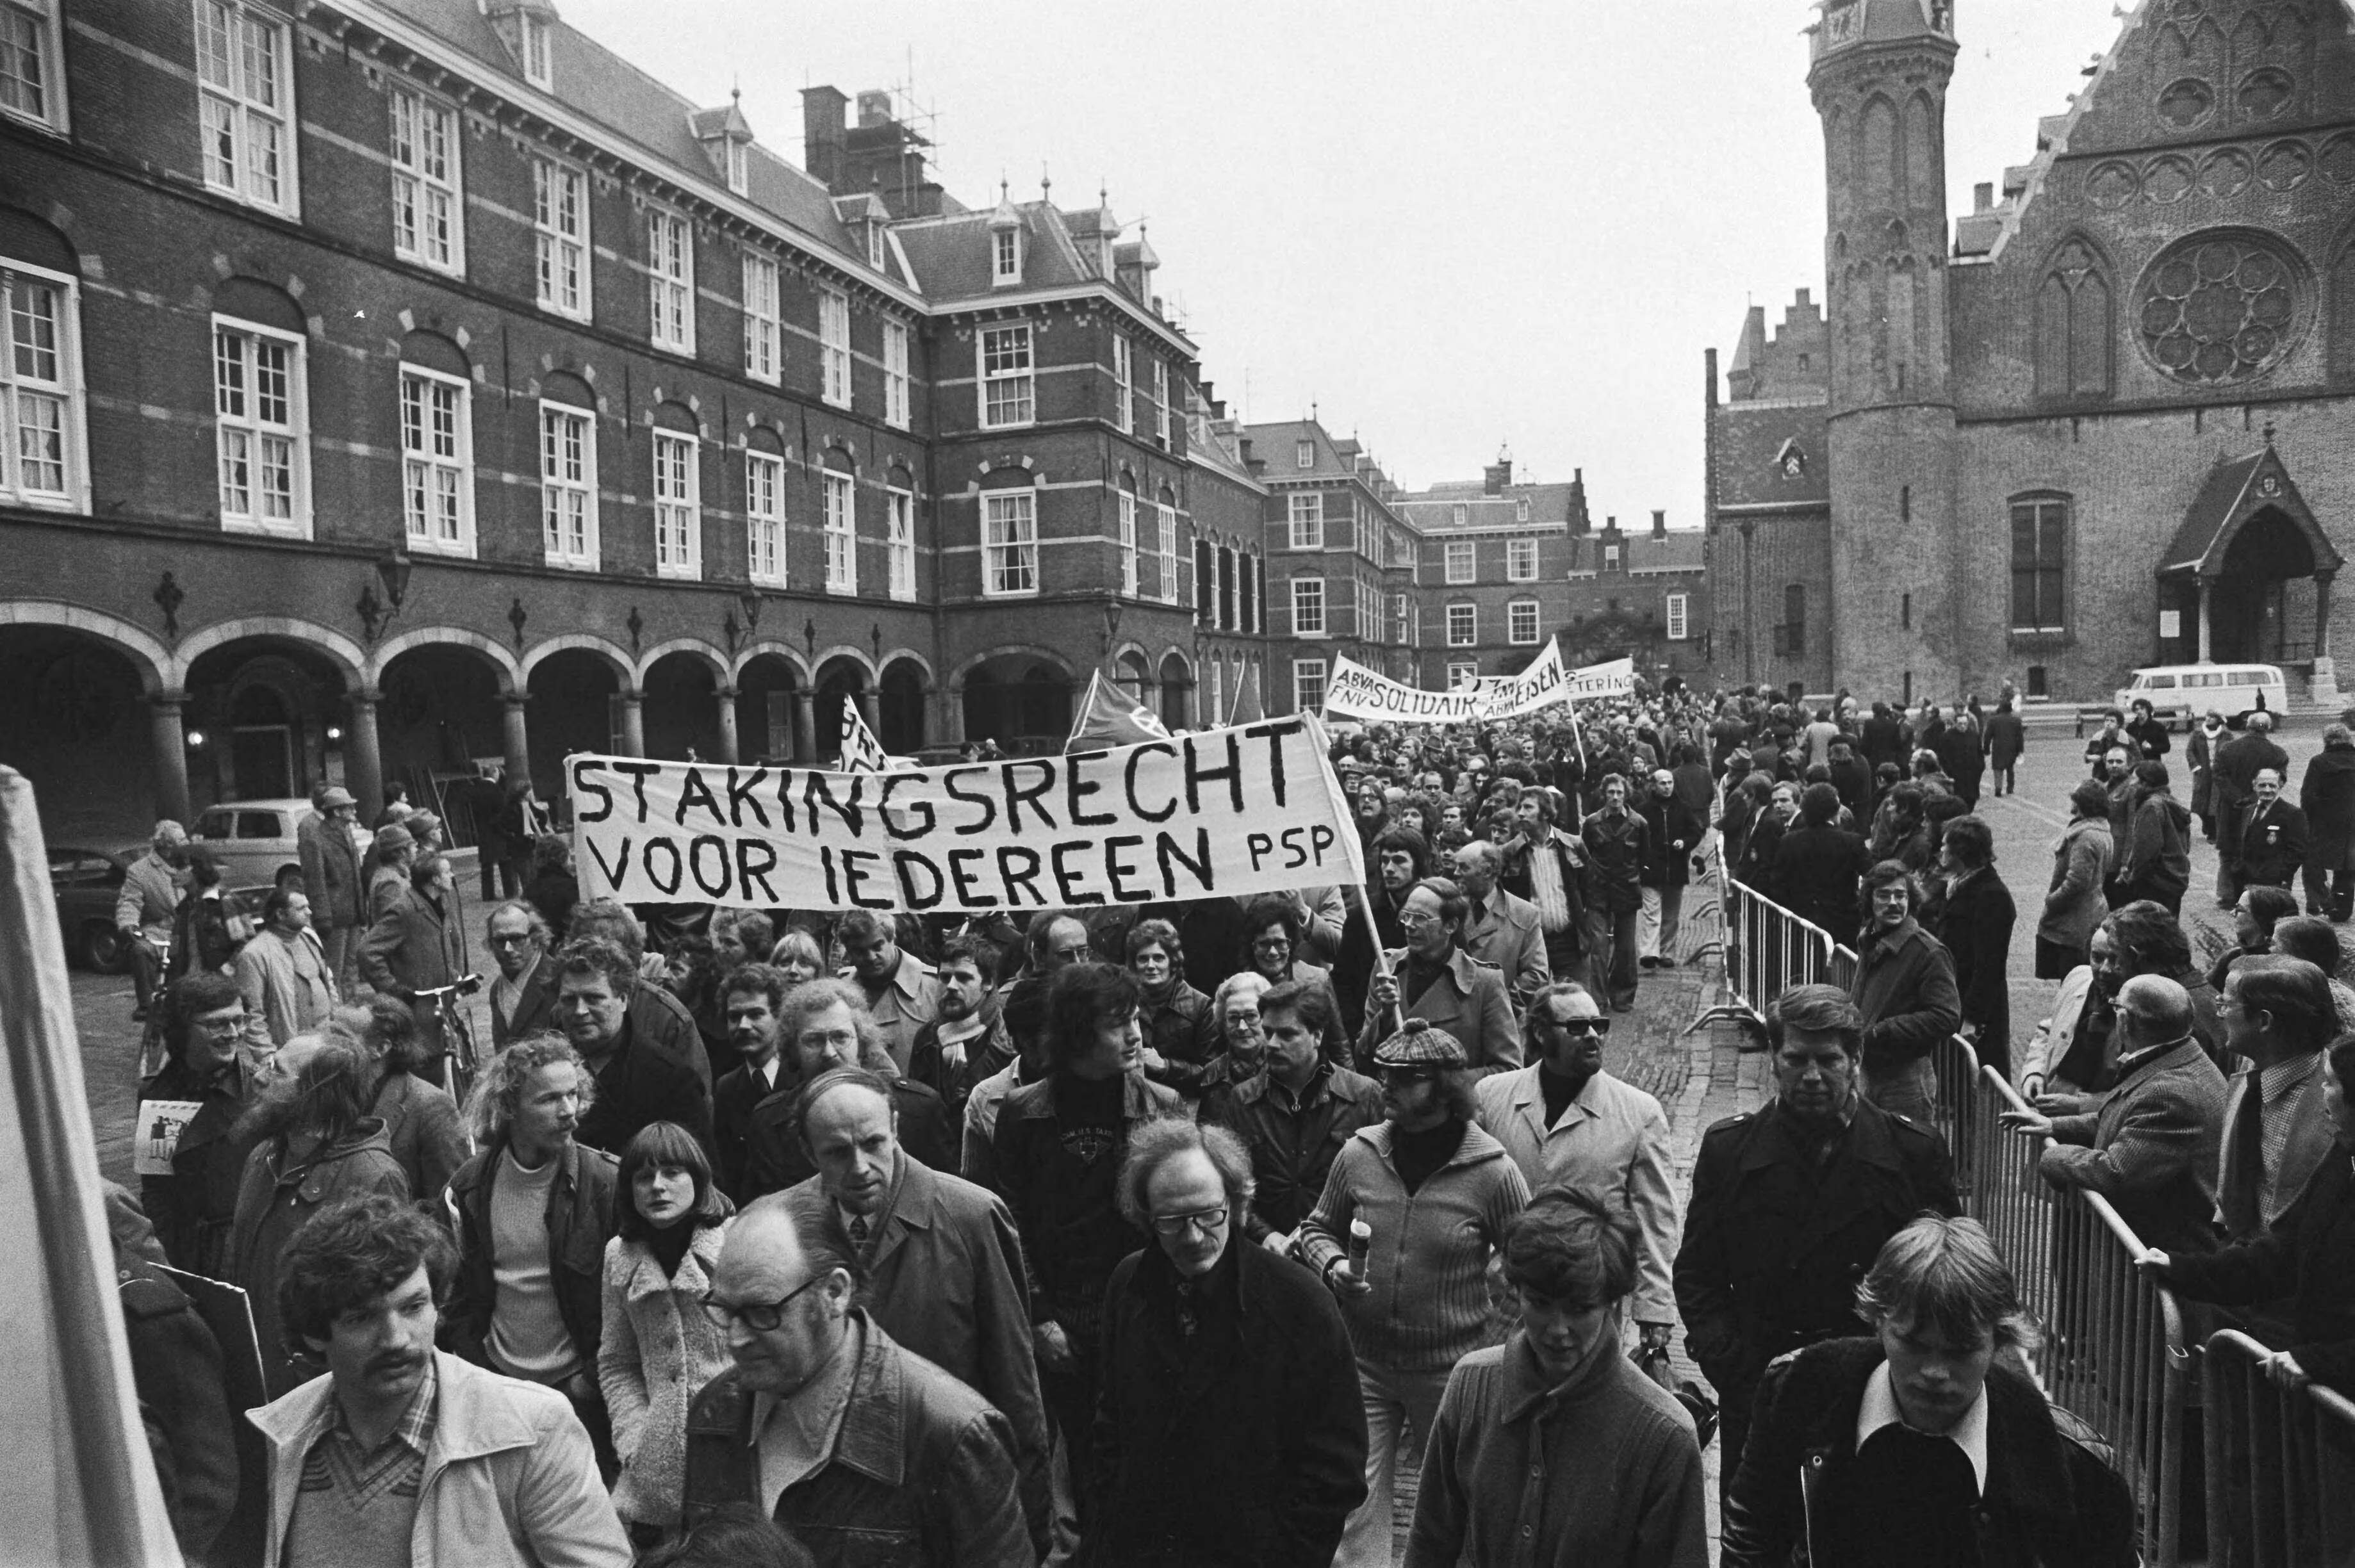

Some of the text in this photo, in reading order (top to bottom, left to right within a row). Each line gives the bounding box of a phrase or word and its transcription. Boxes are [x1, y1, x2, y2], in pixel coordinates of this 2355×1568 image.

[1329, 685, 1368, 707] FNV
[1336, 668, 1374, 692] ABVA
[1370, 657, 1561, 715] SOLIDAIR EISEN
[577, 719, 1304, 841] STAKINGSRECHT
[586, 824, 1334, 910] VOOR IEDEREEN PSP
